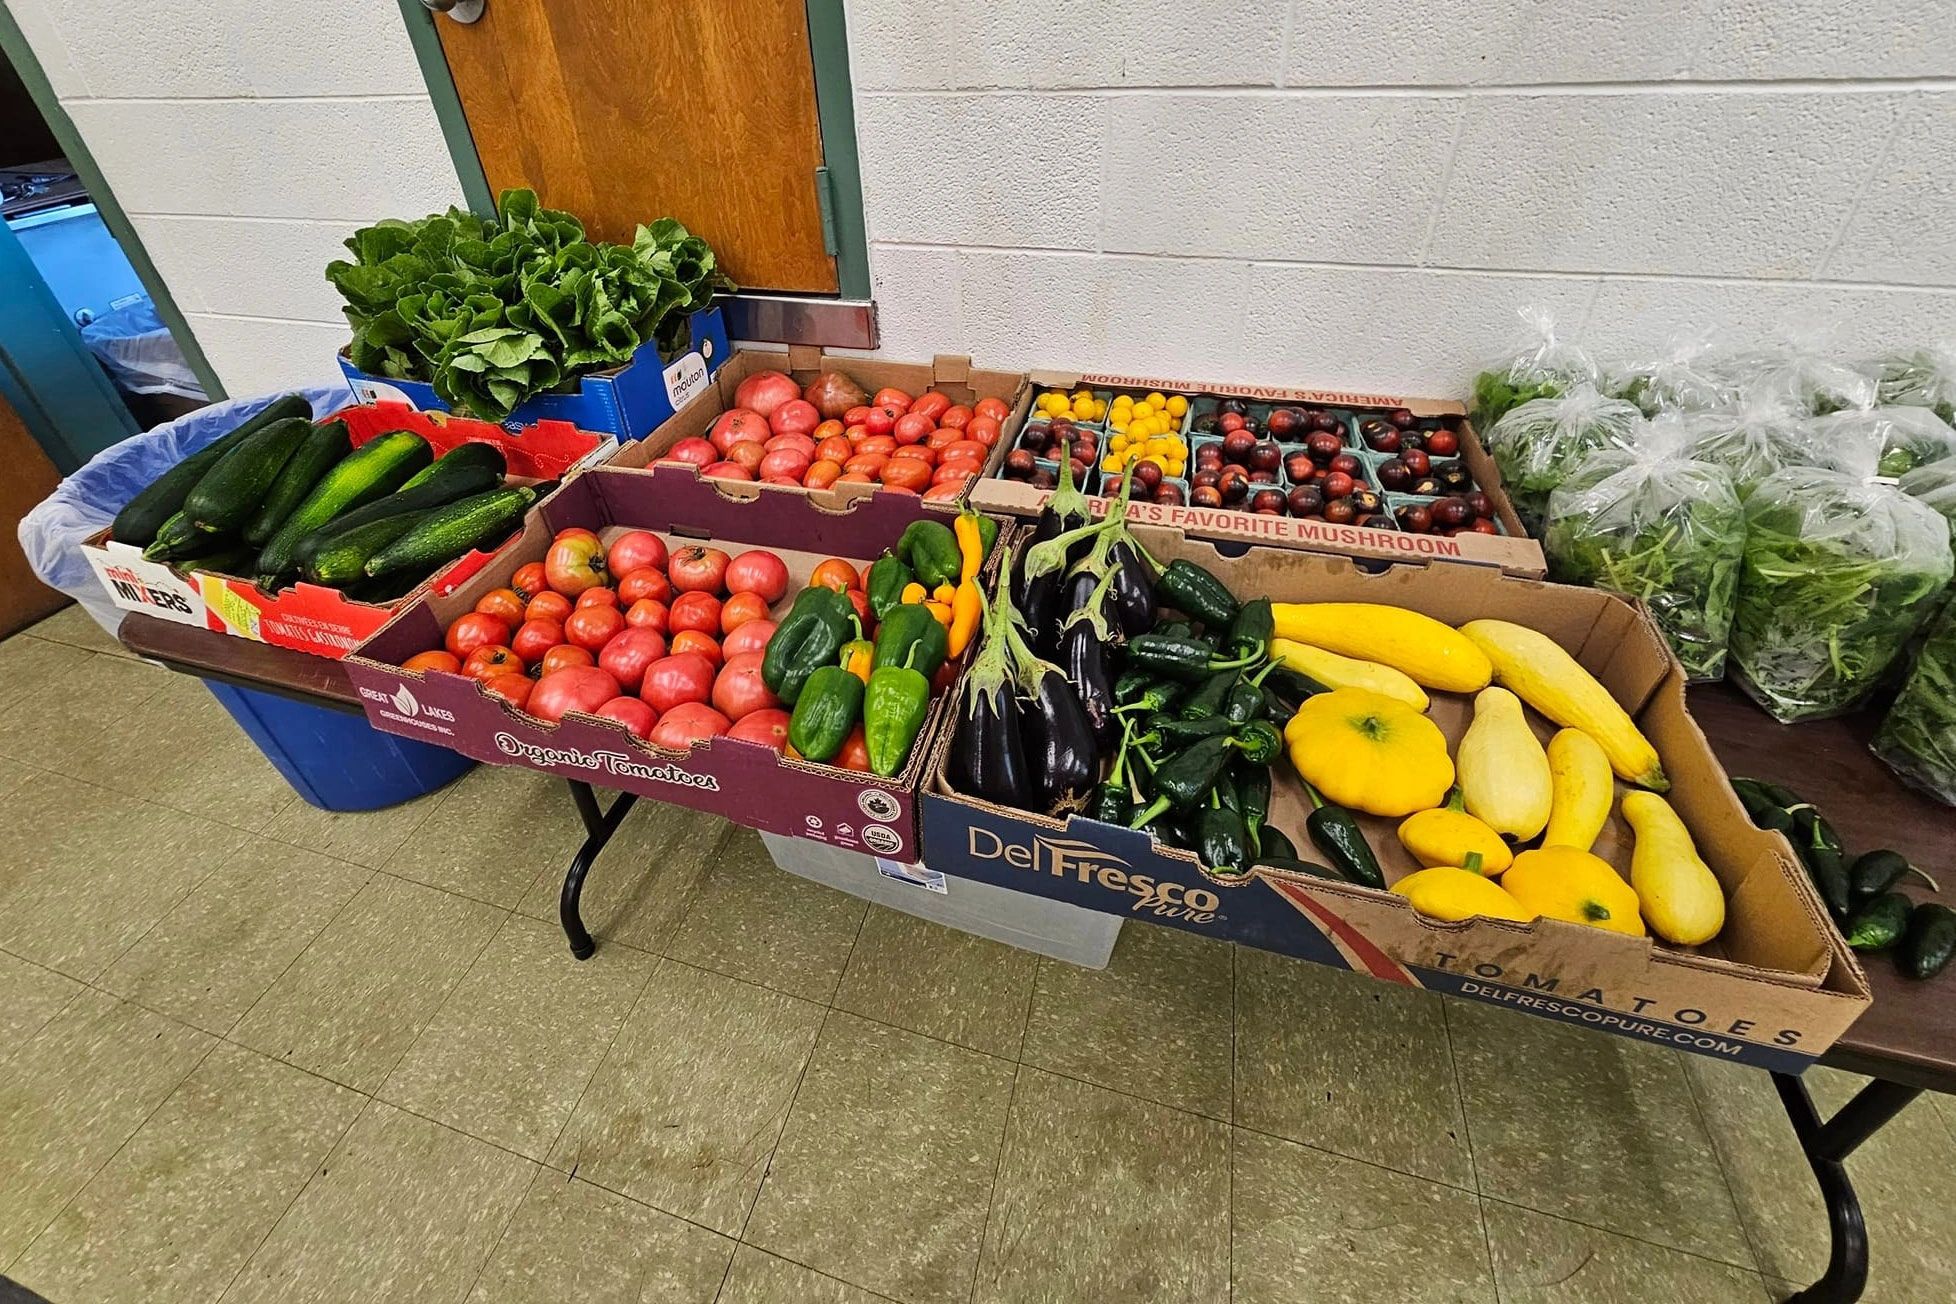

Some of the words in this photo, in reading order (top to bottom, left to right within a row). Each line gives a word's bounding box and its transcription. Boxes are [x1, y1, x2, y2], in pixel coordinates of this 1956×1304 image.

[673, 368, 704, 398] mouton
[1081, 373, 1191, 390] MUSHROOM
[1198, 382, 1287, 398] FAVORITE
[1294, 390, 1404, 407] AMERICA'S
[1171, 508, 1290, 536] FAVORITE
[1297, 524, 1462, 557] MUSHROOM
[104, 566, 139, 583] mini
[111, 579, 193, 614] MIXERS
[359, 686, 389, 704] GREAT
[421, 703, 455, 722] LAKES
[379, 709, 437, 732] GREENHOUSES
[495, 731, 598, 766] Organic
[594, 750, 720, 791] Tomatoes
[871, 830, 891, 840] USDA
[1436, 952, 1802, 1046] TOMATOES
[1460, 982, 1742, 1056] DELFRESCOPURE.COM
